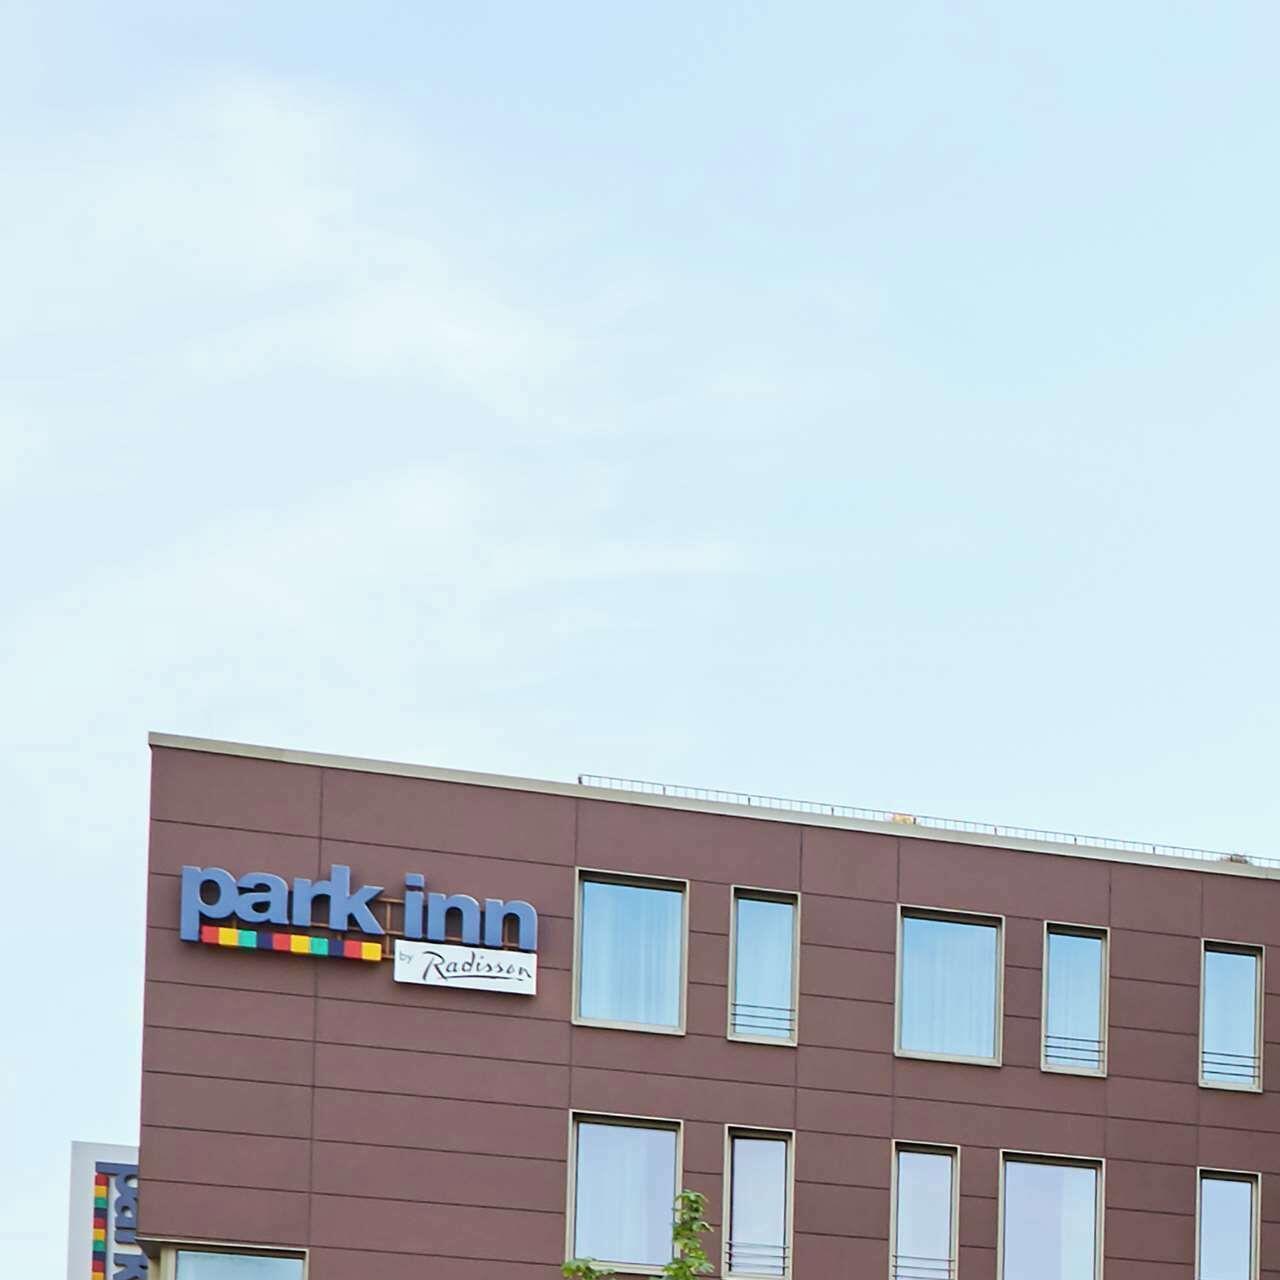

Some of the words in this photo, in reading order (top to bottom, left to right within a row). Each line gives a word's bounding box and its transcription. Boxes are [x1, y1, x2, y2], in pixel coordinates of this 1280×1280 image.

[180, 865, 385, 941] park
[403, 873, 538, 950] inn
[399, 951, 413, 964] by
[422, 950, 533, 982] Radisson
